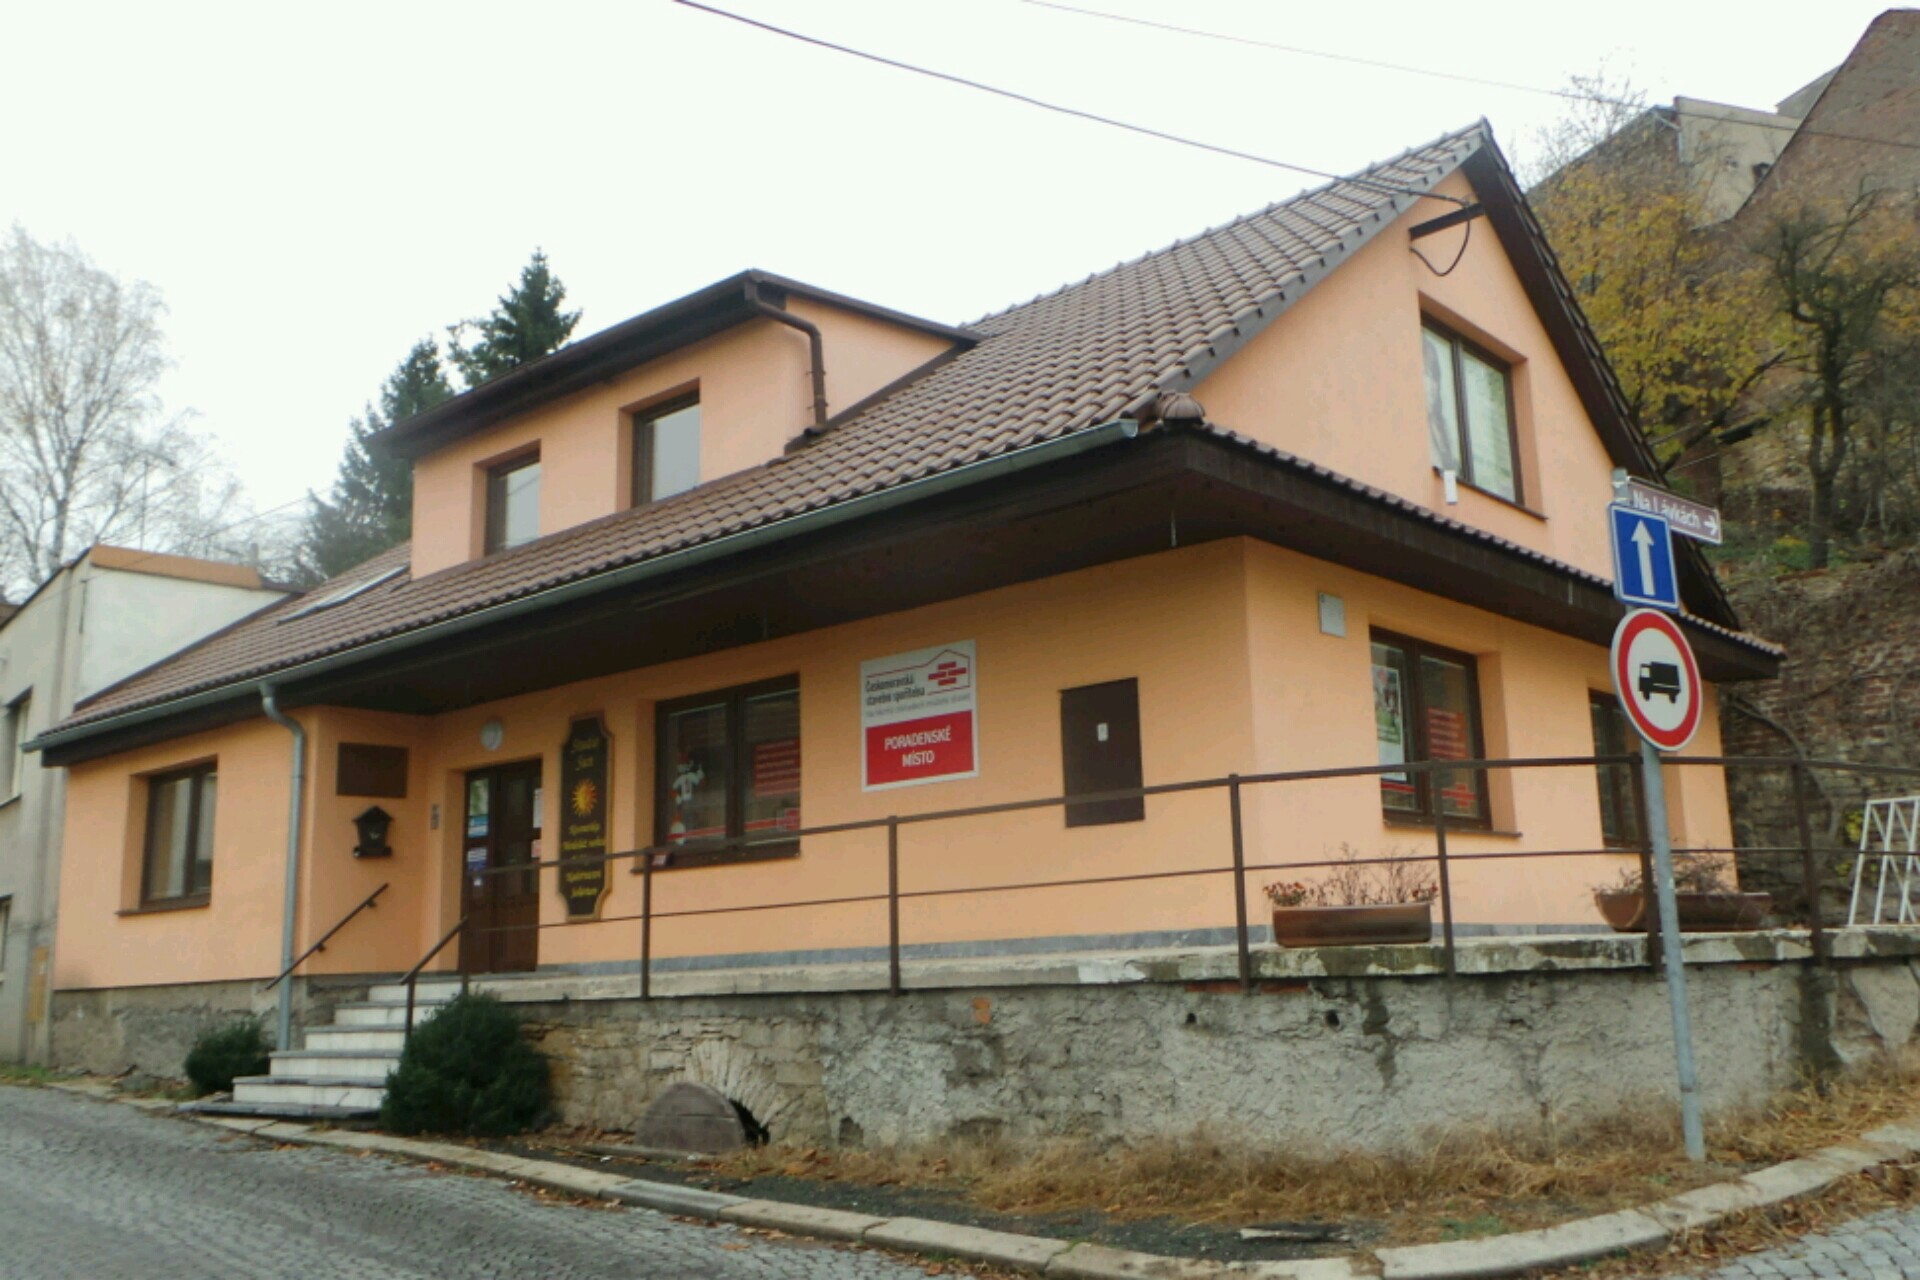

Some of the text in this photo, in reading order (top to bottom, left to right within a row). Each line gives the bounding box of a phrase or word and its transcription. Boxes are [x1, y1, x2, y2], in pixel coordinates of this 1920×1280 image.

[1632, 489, 1651, 512] Na
[884, 725, 952, 751] PORADENSKÉ
[902, 750, 936, 768] MÍSTO
